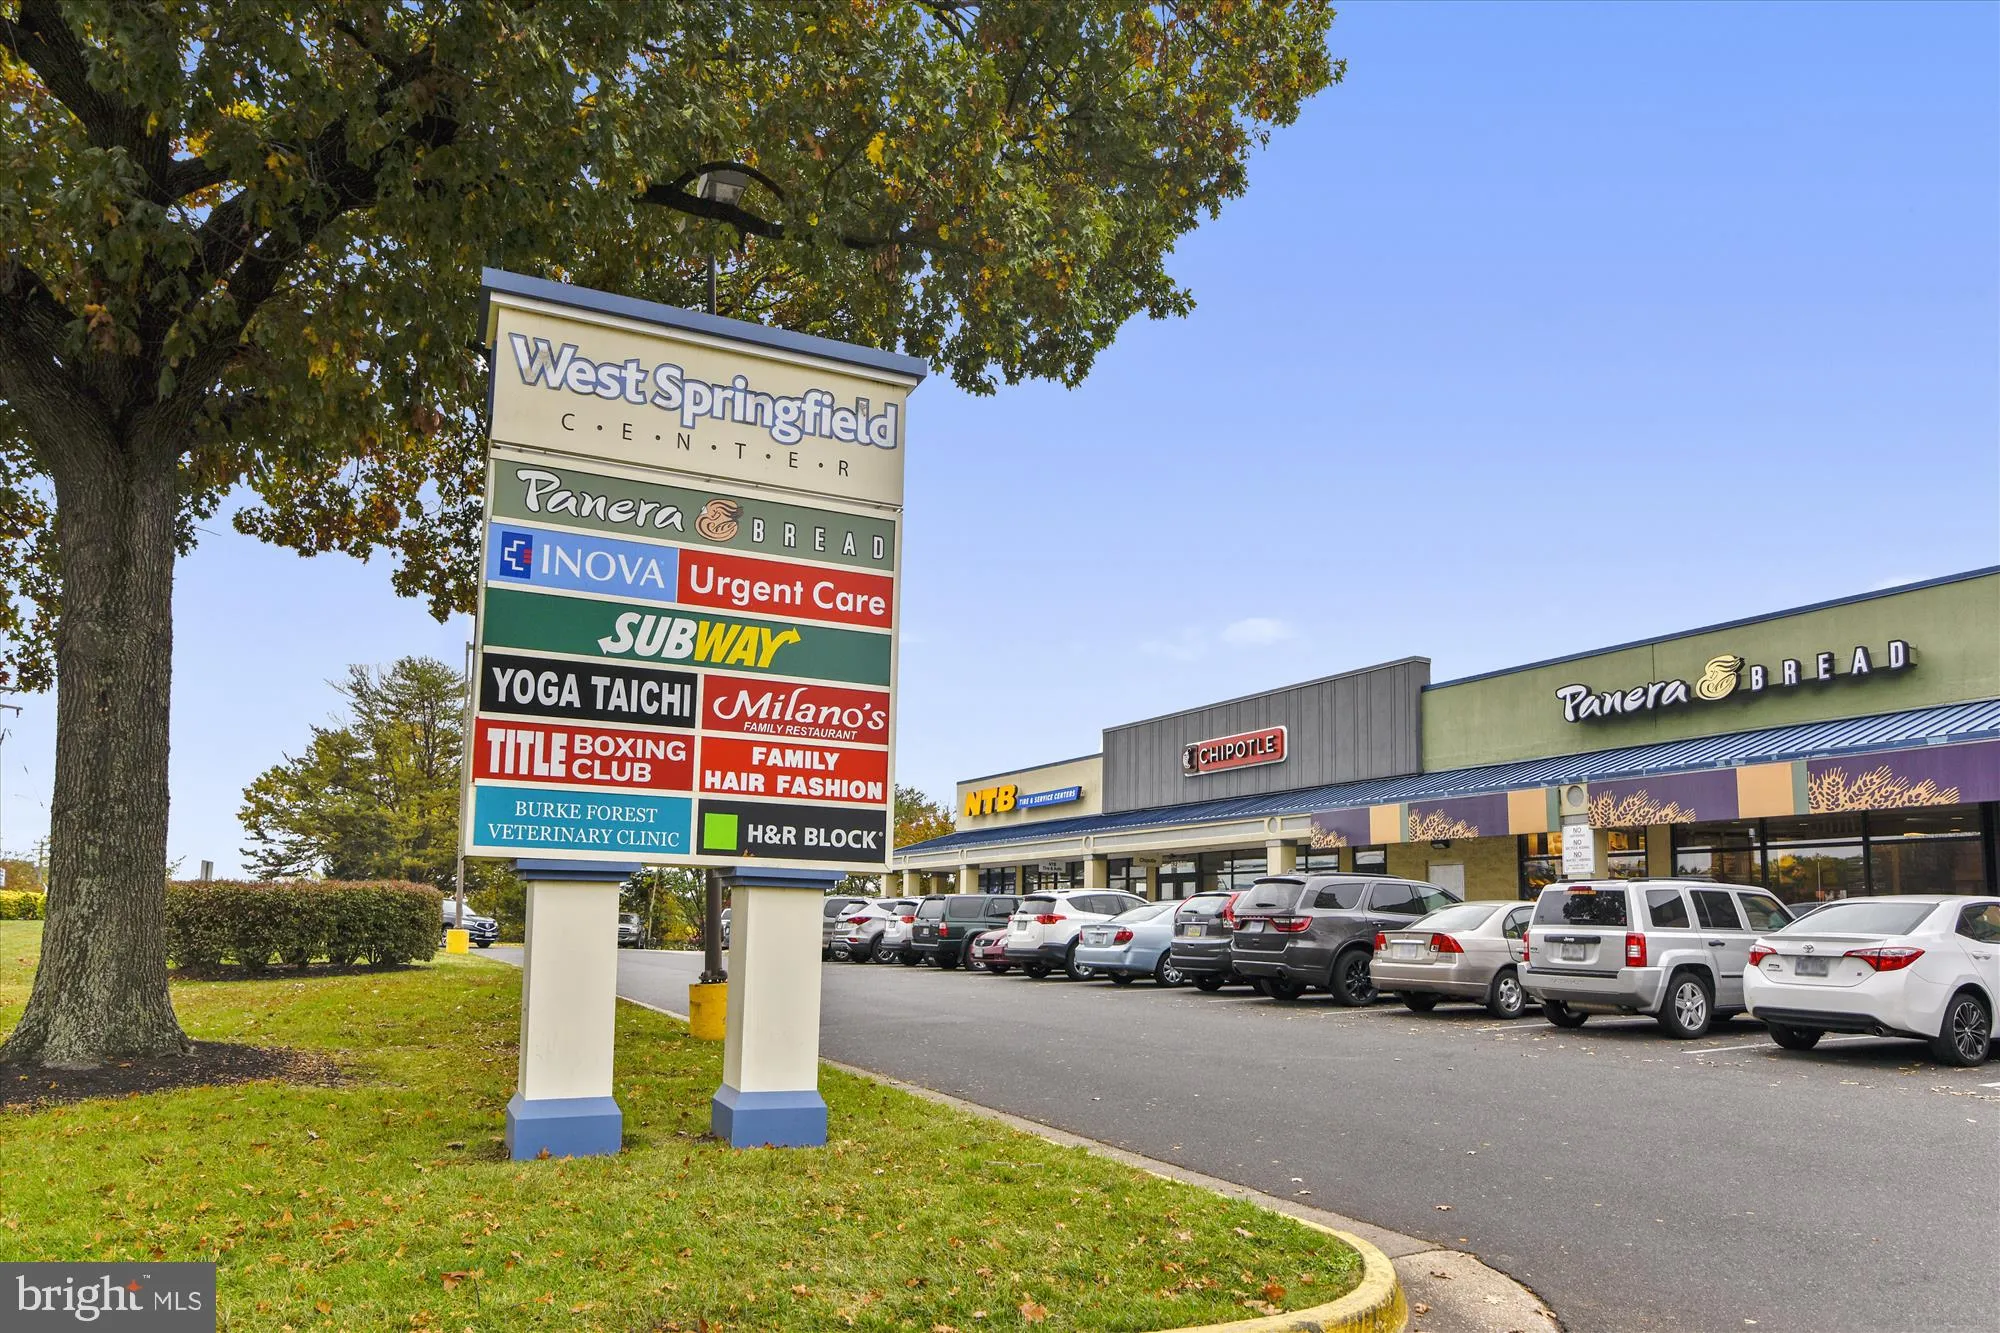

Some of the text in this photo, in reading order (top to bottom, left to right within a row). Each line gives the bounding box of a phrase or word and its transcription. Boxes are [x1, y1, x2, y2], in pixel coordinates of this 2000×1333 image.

[508, 332, 898, 449] West Springfield
[516, 468, 884, 560] Panera BREAD
[541, 544, 665, 589] INOVA
[690, 565, 886, 616] Urgent Care
[597, 612, 801, 668] SUBWAY
[492, 667, 691, 718] YOGA TAICHI
[1555, 640, 1906, 722] Panera BREAD
[712, 687, 887, 731] Milano's
[743, 722, 857, 741] FAMILY RESTAURANT
[487, 727, 686, 777] TITLE BOXING
[752, 746, 840, 771] FAMILY
[1199, 735, 1275, 764] CHIPOTLE
[572, 758, 652, 783] CLUB
[704, 770, 882, 800] HAIR FASHION
[515, 800, 658, 823] BURKE FOREST
[963, 784, 1017, 817] NTB
[1019, 797, 1029, 806] TIRE
[1034, 793, 1053, 804] SERVICE
[1053, 789, 1076, 800] CENTERS
[488, 823, 680, 847] VETERINARY CLINIC
[747, 824, 797, 846] H&R
